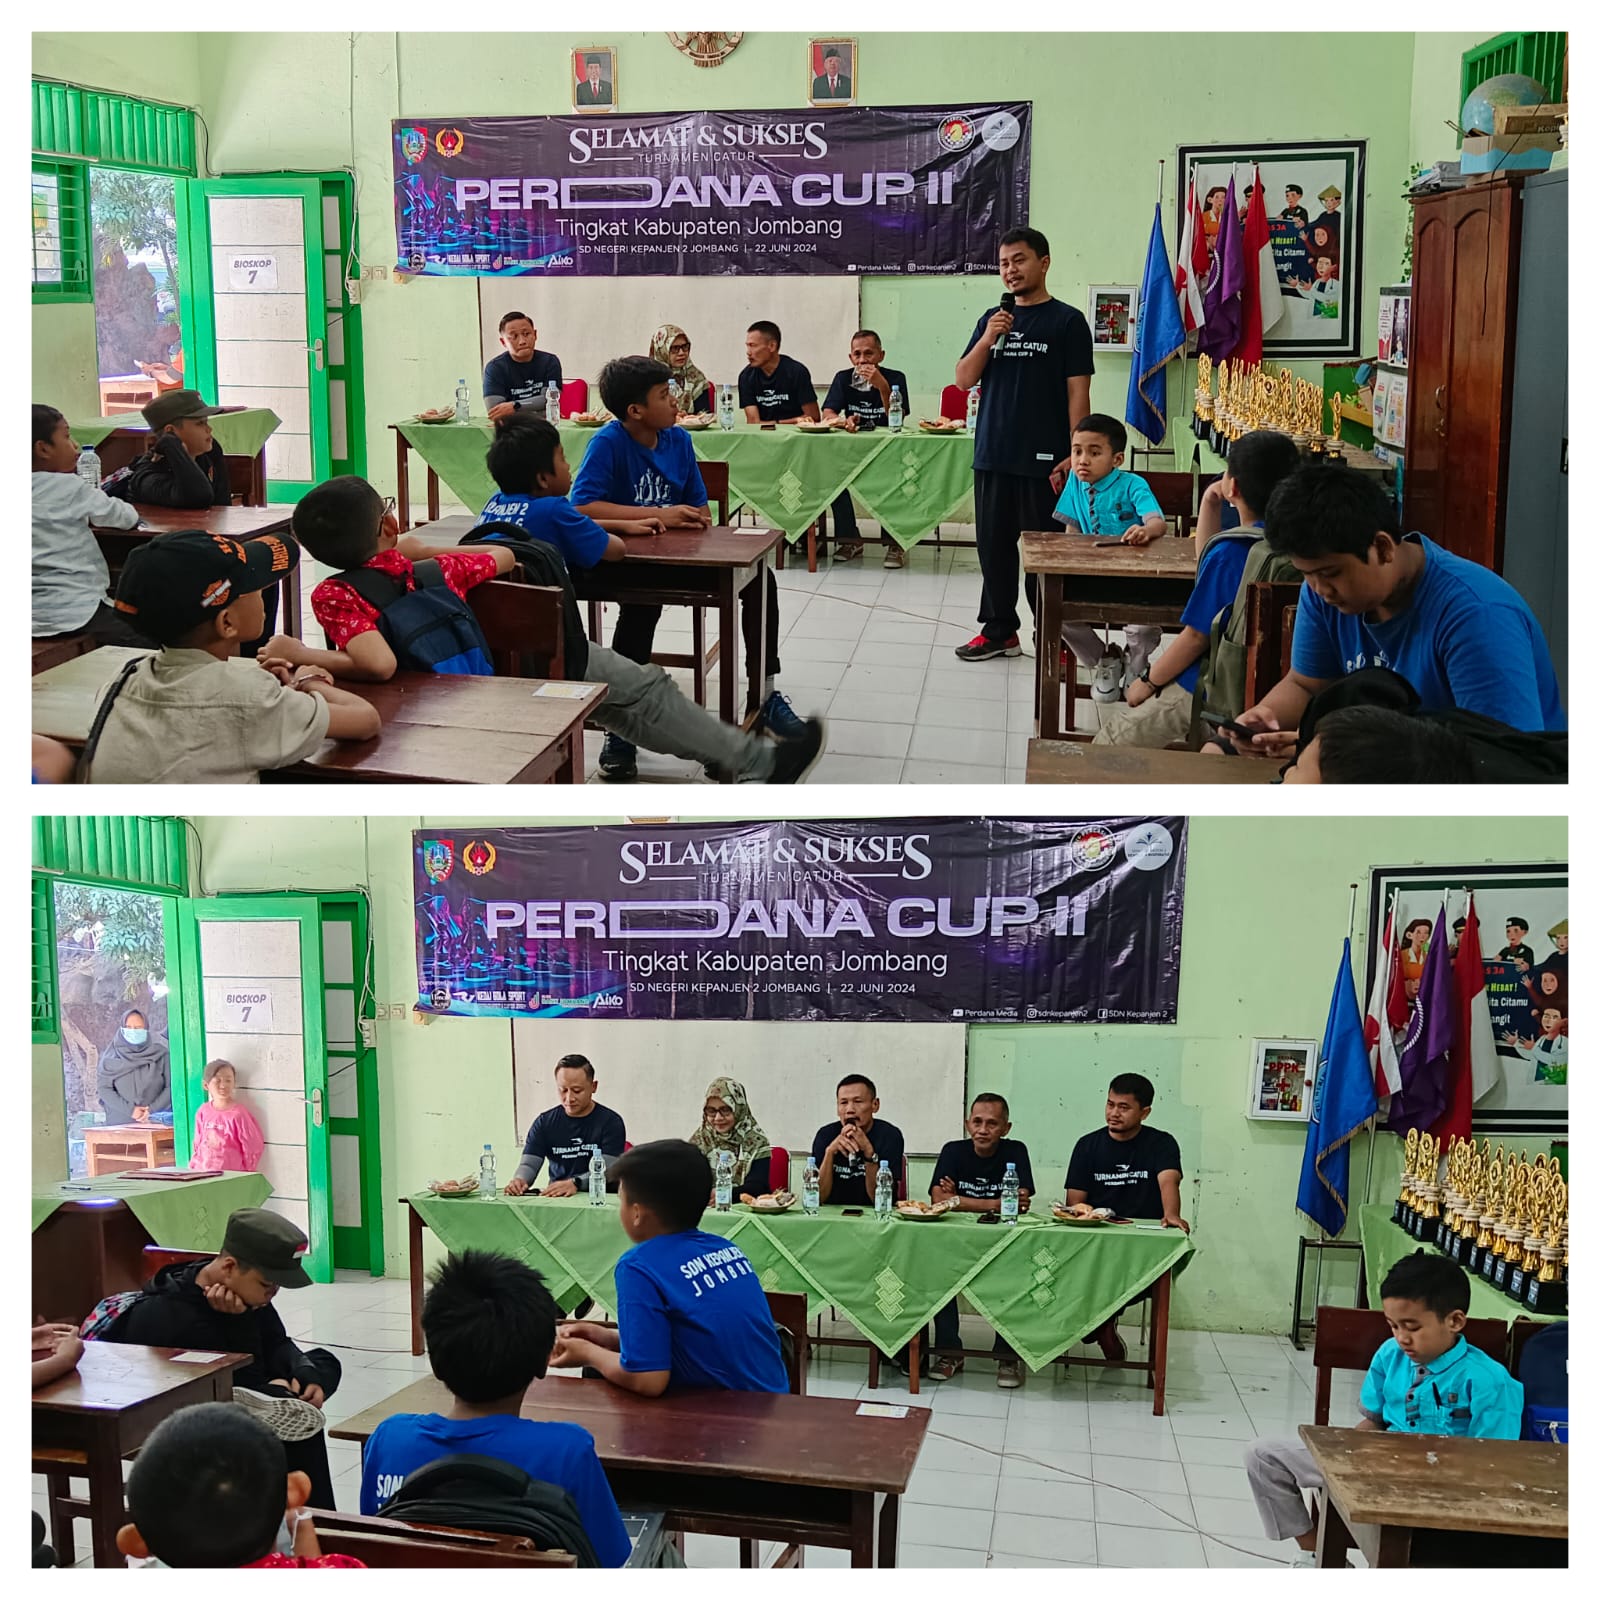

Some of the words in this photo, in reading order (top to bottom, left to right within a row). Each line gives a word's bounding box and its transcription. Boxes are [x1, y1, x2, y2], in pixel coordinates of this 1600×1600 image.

[569, 126, 692, 164] SELAMAT
[697, 125, 718, 146] &
[723, 122, 828, 160] SUKSES
[638, 152, 706, 163] TURNAMEN
[714, 151, 755, 162] CATUR
[455, 174, 783, 211] PERDANA
[792, 172, 915, 207] CUP
[927, 171, 953, 205] II
[555, 217, 629, 241] Tingkat
[635, 216, 741, 239] Kabupaten
[747, 216, 842, 239] Jombang
[578, 245, 592, 253] SD
[594, 245, 629, 253] NEGERI
[631, 245, 680, 253] KEPANJEN
[682, 245, 688, 253] 2
[690, 244, 739, 253] JOMBANG
[755, 244, 767, 253] 22
[768, 243, 791, 252] JUNI
[793, 243, 817, 252] 2024
[233, 259, 272, 269] BIOSKOP
[248, 270, 258, 285] 7
[1023, 341, 1049, 354] CATUR
[520, 503, 529, 516] 2
[619, 838, 768, 885] SELAMAT
[773, 838, 799, 863] &
[804, 834, 933, 881] SUKSES
[702, 871, 789, 884] TURNAMEN
[793, 870, 842, 882] CATUR
[487, 898, 876, 939] PERDANA
[887, 895, 1041, 938] CUP
[1054, 894, 1089, 936] II
[602, 949, 689, 976] Tingkat
[695, 948, 824, 974] Kabupaten
[832, 949, 948, 976] Jombang
[629, 982, 645, 993] SD
[647, 982, 689, 993] NEGERI
[691, 982, 750, 993] KEPANJEN
[753, 983, 760, 993] 2
[762, 982, 821, 993] JOMBANG
[840, 983, 854, 993] 22
[857, 982, 884, 993] JUNI
[887, 982, 916, 993] 2024
[226, 994, 268, 1004] BIOSKOP
[1500, 997, 1529, 1007] Citamu
[241, 1006, 252, 1023] 7
[1108, 1010, 1126, 1018] SDN
[1127, 1010, 1161, 1019] Kepanjen
